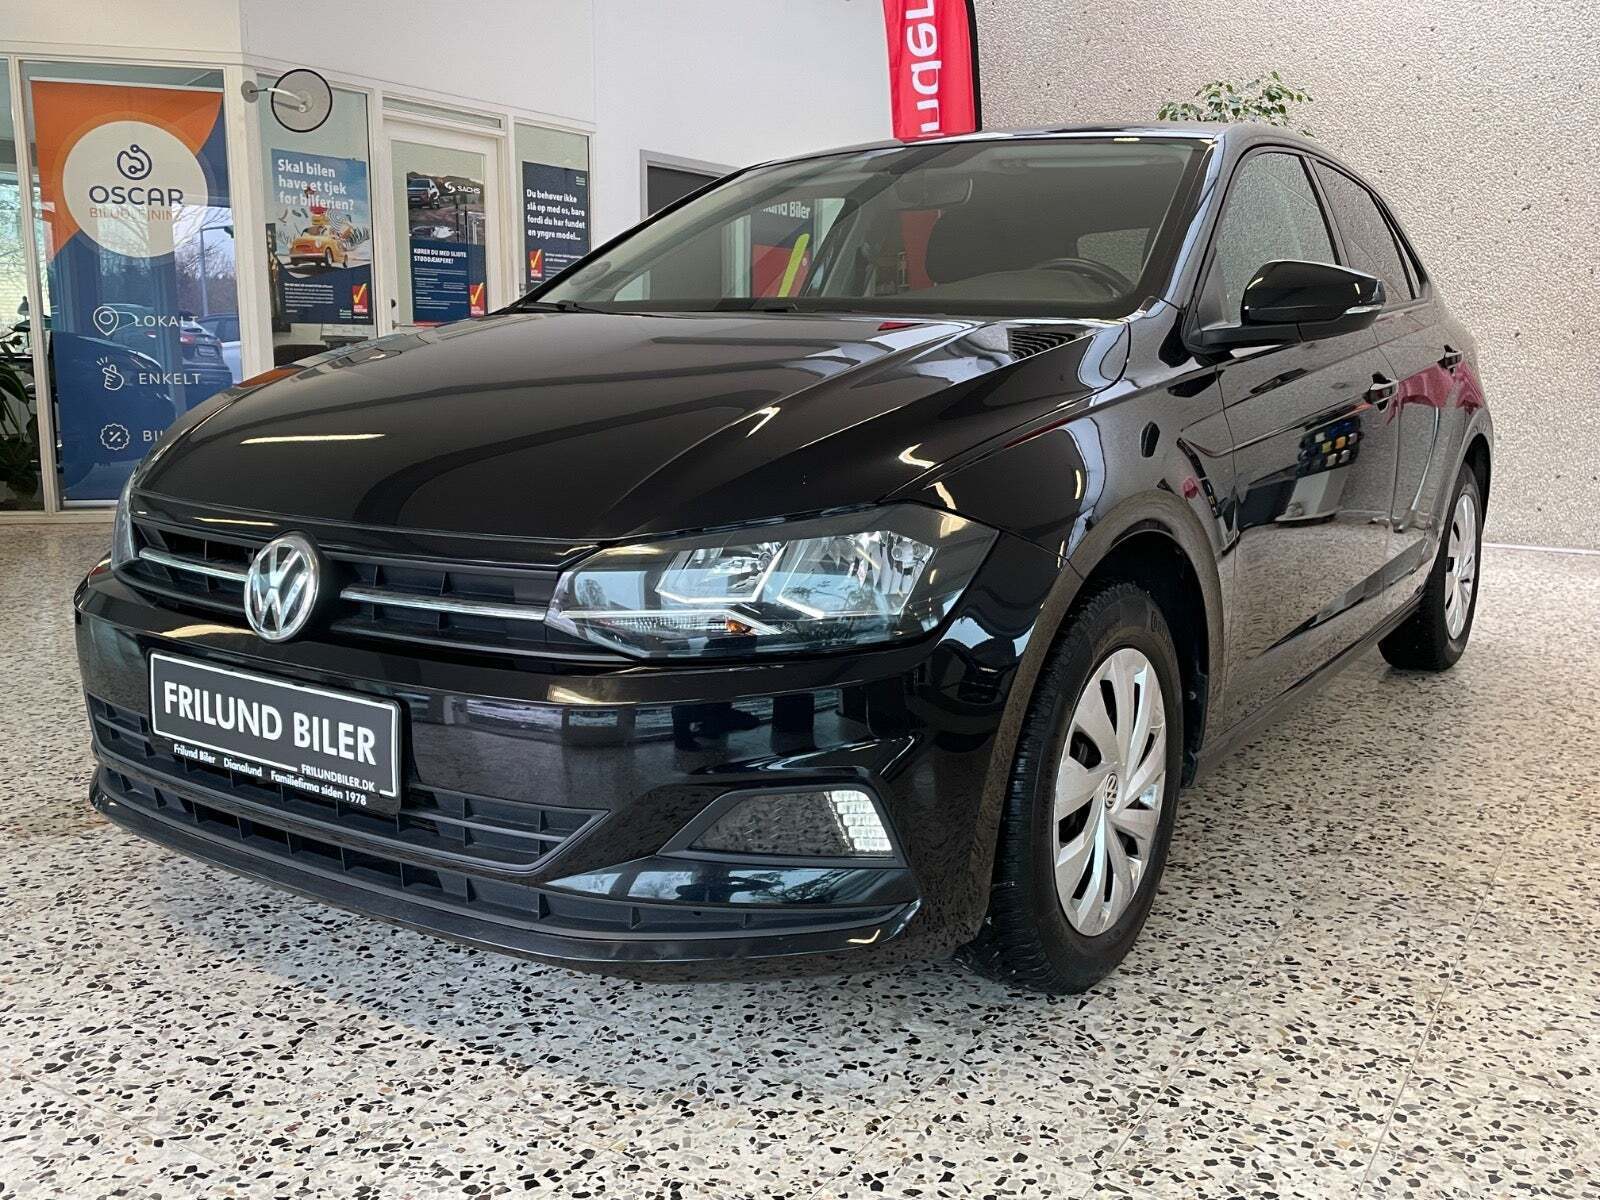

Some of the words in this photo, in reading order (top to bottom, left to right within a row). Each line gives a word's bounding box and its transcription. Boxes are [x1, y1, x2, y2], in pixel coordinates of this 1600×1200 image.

[278, 159, 303, 174] Skal
[306, 163, 336, 178] bilen
[278, 175, 307, 190] have
[310, 181, 322, 192] et
[324, 182, 347, 196] tjek
[457, 185, 481, 194] SACHS
[89, 186, 184, 208] OSCAR
[279, 191, 297, 205] for
[300, 194, 354, 211] bilferien?
[527, 189, 536, 198] Du
[563, 194, 577, 203] ikke
[527, 201, 536, 211] slå
[537, 205, 546, 213] op
[546, 204, 560, 213] med
[571, 207, 585, 217] bare
[789, 201, 811, 219] Biler
[527, 214, 543, 224] fordi
[544, 216, 553, 226] du
[553, 217, 564, 226] har
[564, 218, 586, 229] fundet
[528, 229, 536, 237] en
[536, 230, 556, 240] yngre
[135, 315, 199, 329] LOKALT
[139, 373, 201, 386] ENKELT
[164, 681, 282, 741] FRILUND
[293, 712, 377, 766] BILER
[173, 744, 198, 760] Frilund
[199, 748, 216, 765] Biler
[223, 757, 263, 778] Dianalund
[270, 770, 320, 795] Familiefirma
[321, 783, 343, 800] siden
[345, 790, 367, 807] 1978
[301, 763, 376, 793] FRILUNDBILER.DK
